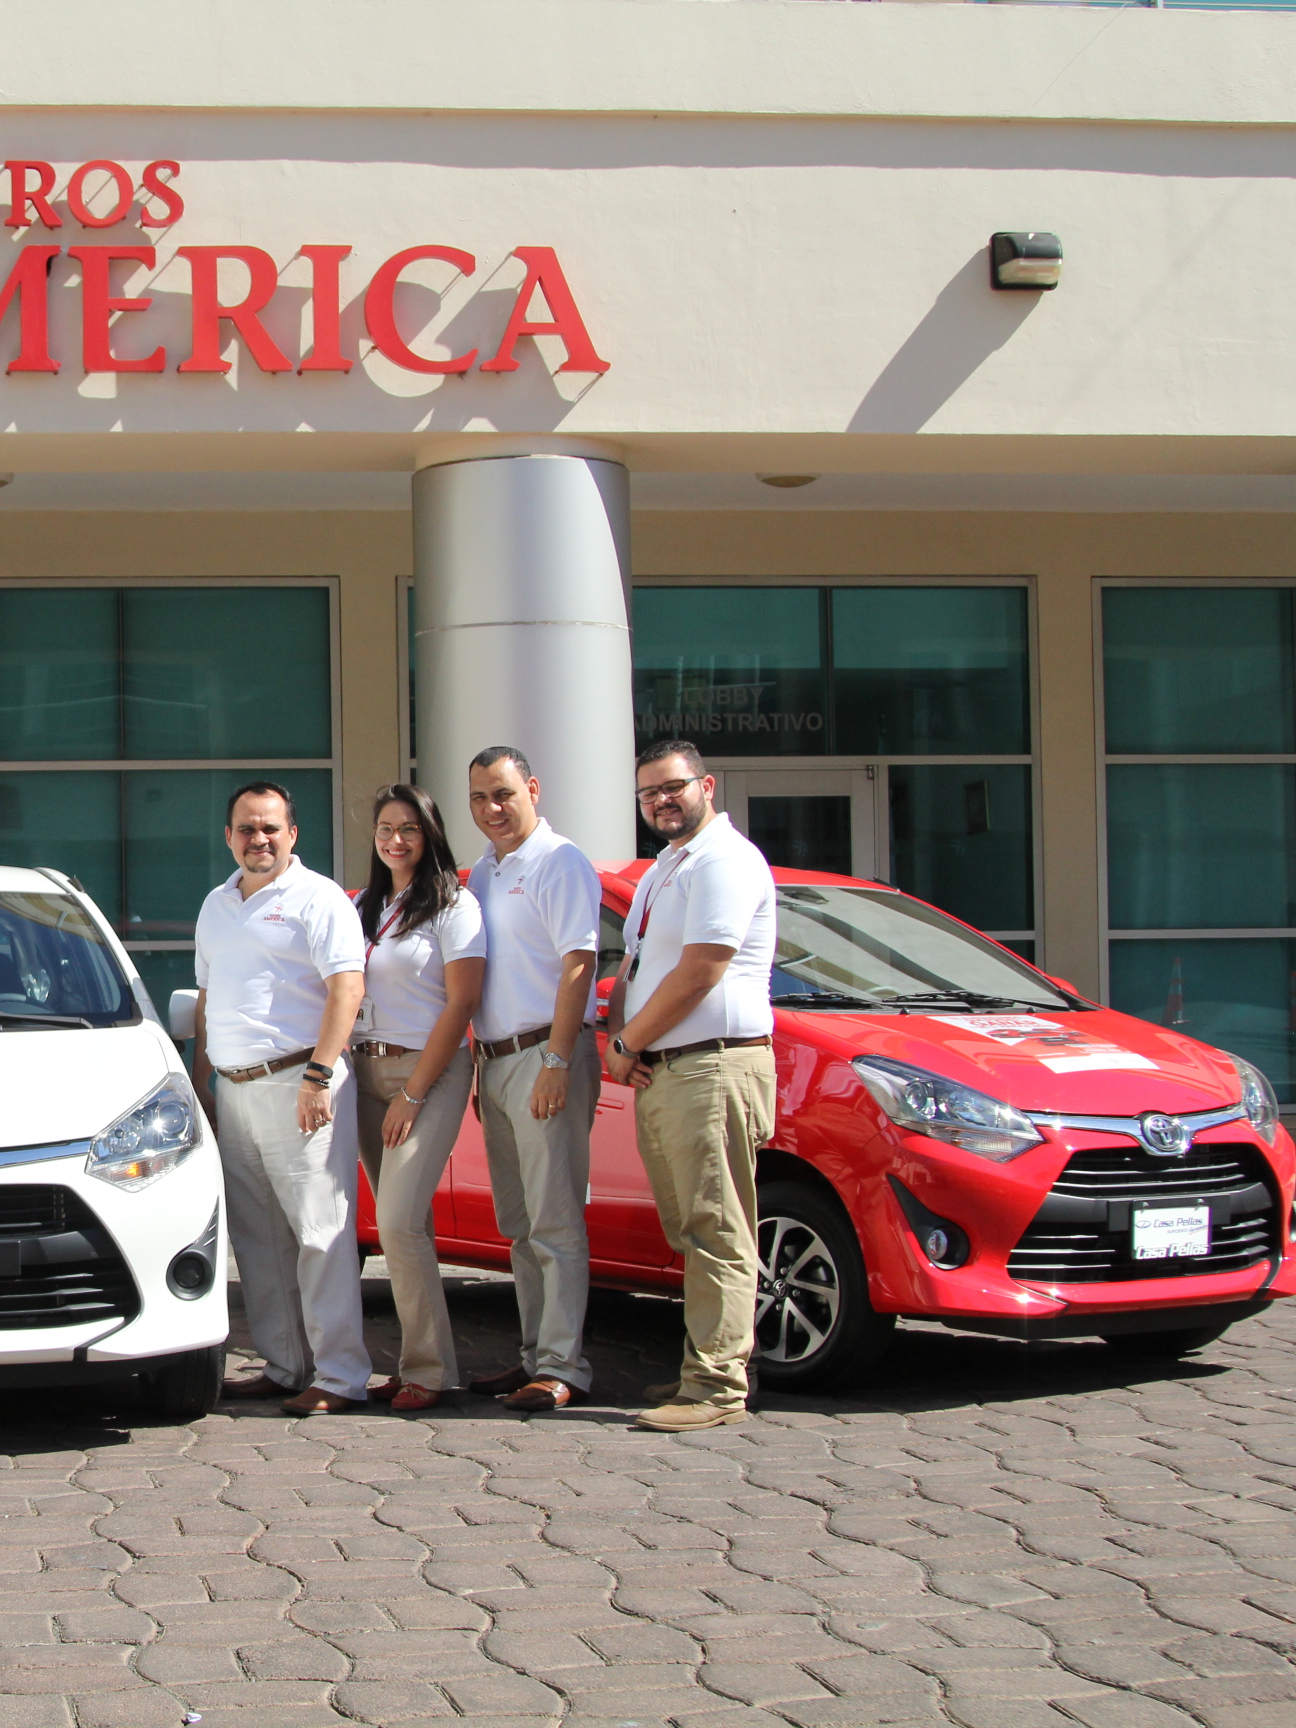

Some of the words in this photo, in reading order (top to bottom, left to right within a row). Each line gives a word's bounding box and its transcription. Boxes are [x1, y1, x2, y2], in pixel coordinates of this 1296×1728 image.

[683, 686, 764, 705] LOBBY
[1154, 1219, 1174, 1228] Casa
[1177, 1217, 1203, 1226] Pellas
[1136, 1245, 1167, 1260] Casa
[1168, 1242, 1208, 1258] Pellas
